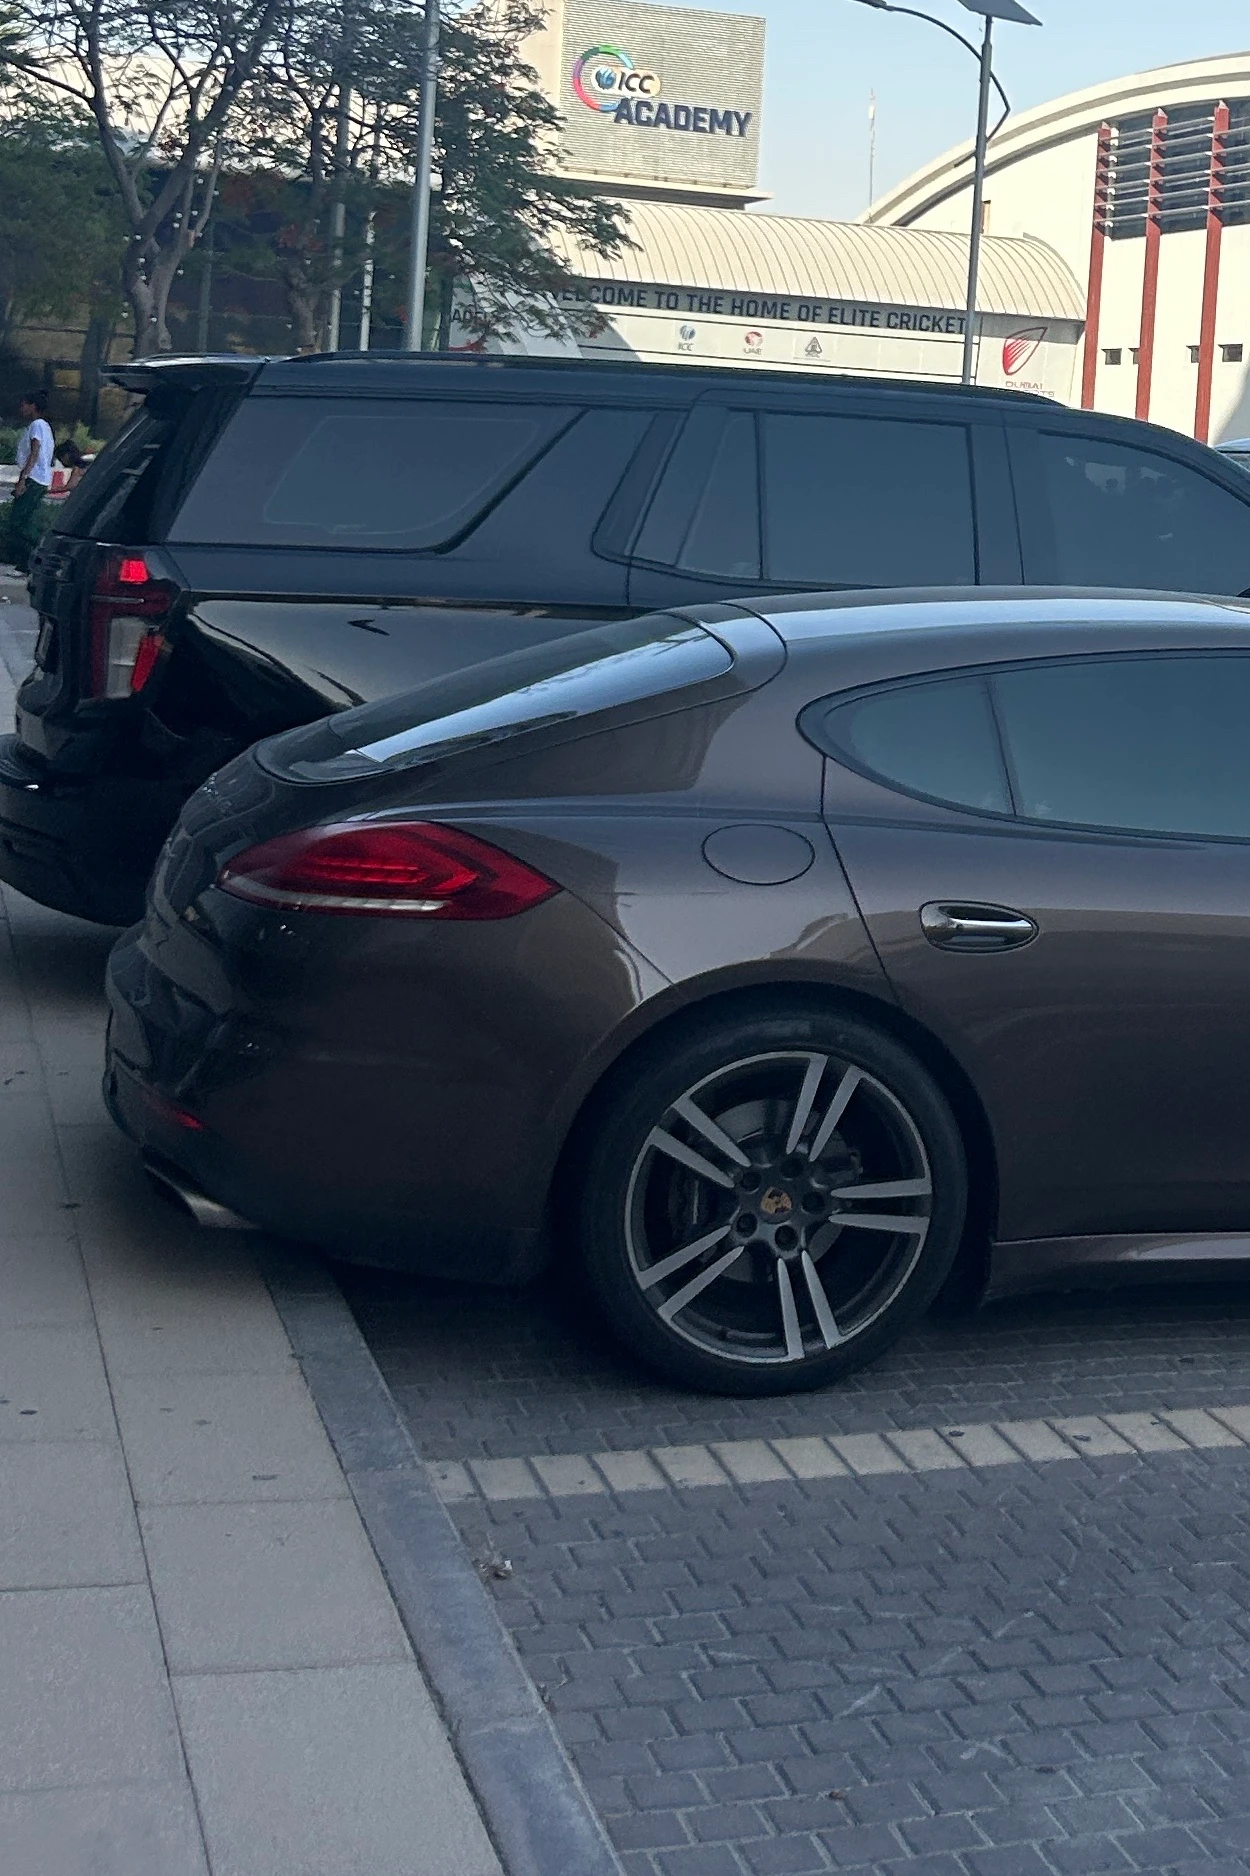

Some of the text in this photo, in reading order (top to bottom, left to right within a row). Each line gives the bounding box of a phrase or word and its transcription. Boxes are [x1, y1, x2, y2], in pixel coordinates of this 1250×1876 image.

[617, 70, 655, 94] ICC
[613, 98, 752, 137] ACADEMY
[554, 284, 966, 335] ELCOME TO THE HOME OF ELITE CRICKET
